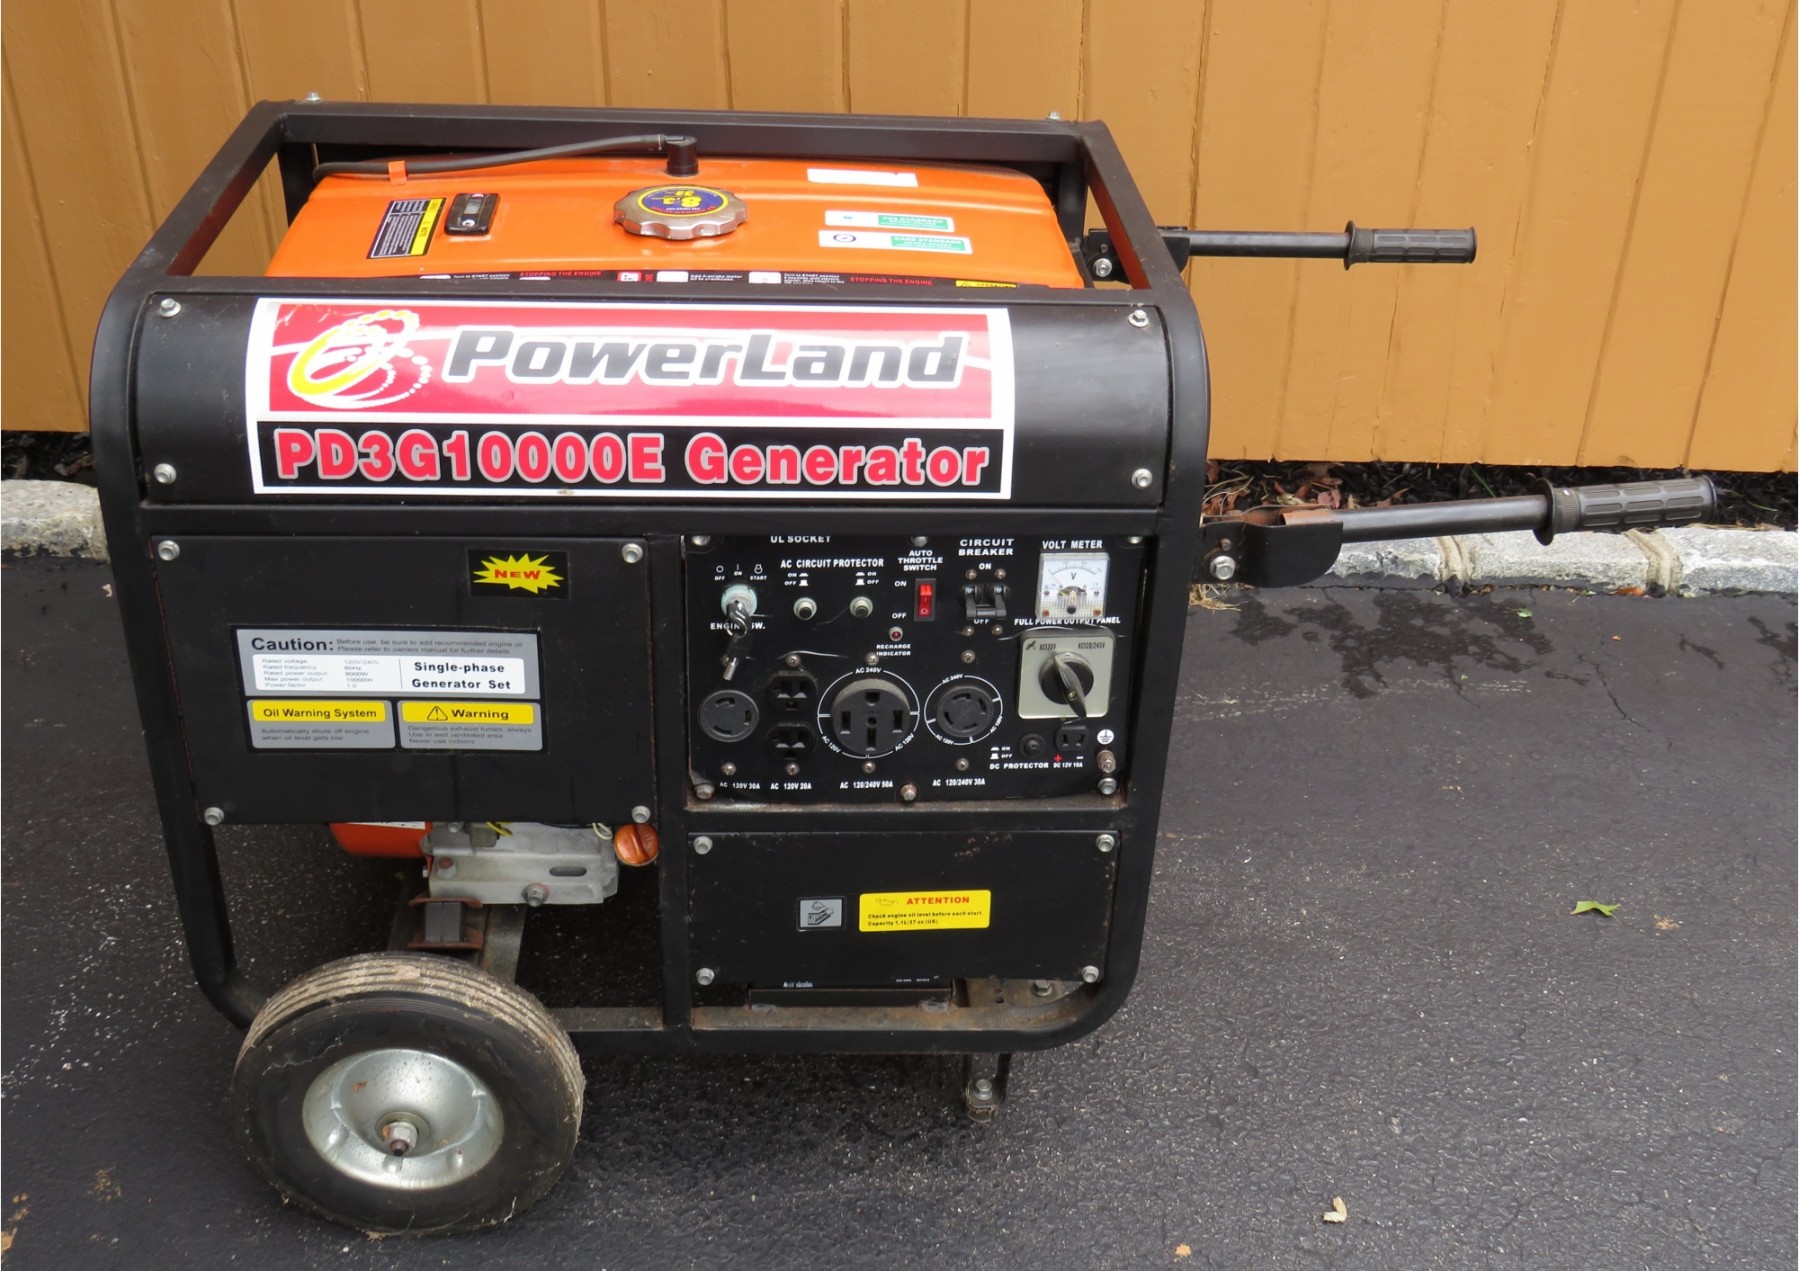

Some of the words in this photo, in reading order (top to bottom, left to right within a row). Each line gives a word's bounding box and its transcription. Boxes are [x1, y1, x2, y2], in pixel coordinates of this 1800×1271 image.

[443, 326, 968, 387] PowerLand
[275, 429, 664, 484] PD3G10000E
[686, 431, 990, 486] Generator
[960, 538, 1014, 547] CIRCUIT
[1042, 541, 1066, 549] VOLT
[1071, 540, 1103, 548] METER
[780, 559, 792, 568] AC
[796, 559, 831, 568] CIRCUIT
[833, 558, 884, 568] PROTECTOR
[494, 569, 541, 580] NEW
[251, 637, 334, 651] Caution:
[414, 661, 505, 674] Single-phase
[412, 678, 481, 690] Generator
[488, 679, 511, 690] Set
[263, 708, 280, 717] Oil
[282, 709, 331, 719] Warning
[334, 709, 377, 719] System
[451, 709, 509, 720] Warning
[821, 735, 830, 744] AC
[828, 742, 841, 753] 120V
[906, 897, 970, 905] ATTENTION
